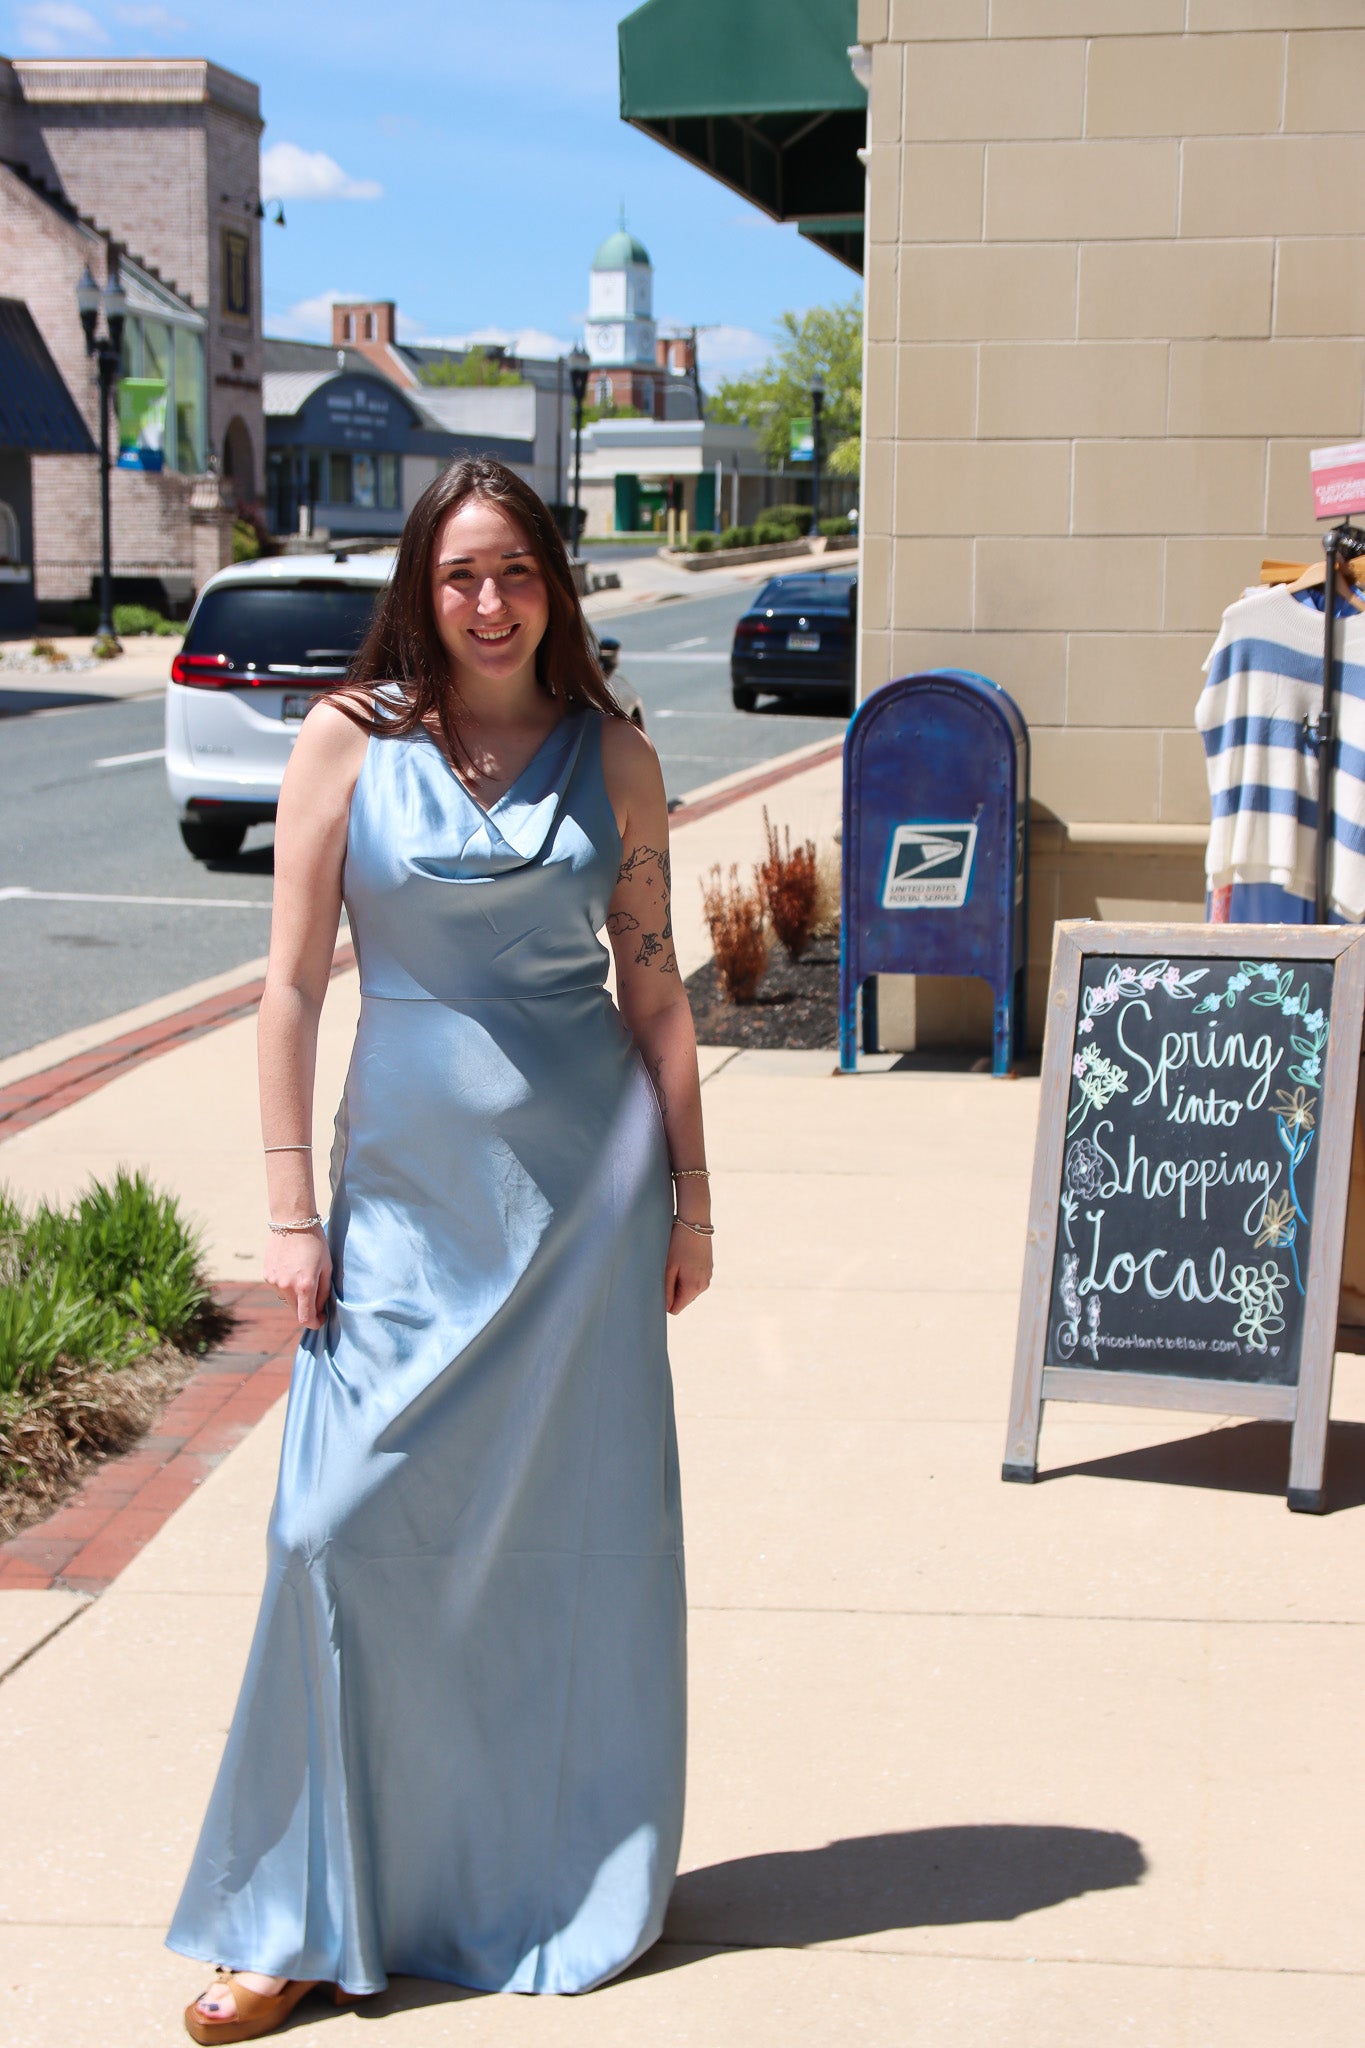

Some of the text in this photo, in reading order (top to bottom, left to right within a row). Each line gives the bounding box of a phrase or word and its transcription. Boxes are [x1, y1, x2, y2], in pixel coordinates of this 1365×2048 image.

[891, 883, 957, 893] UNITED STATES
[924, 893, 958, 902] SERVICE
[1117, 1000, 1284, 1111] Spring
[1166, 1085, 1243, 1126] into
[1092, 1120, 1282, 1236] Shopping
[1078, 1209, 1242, 1304] Local
